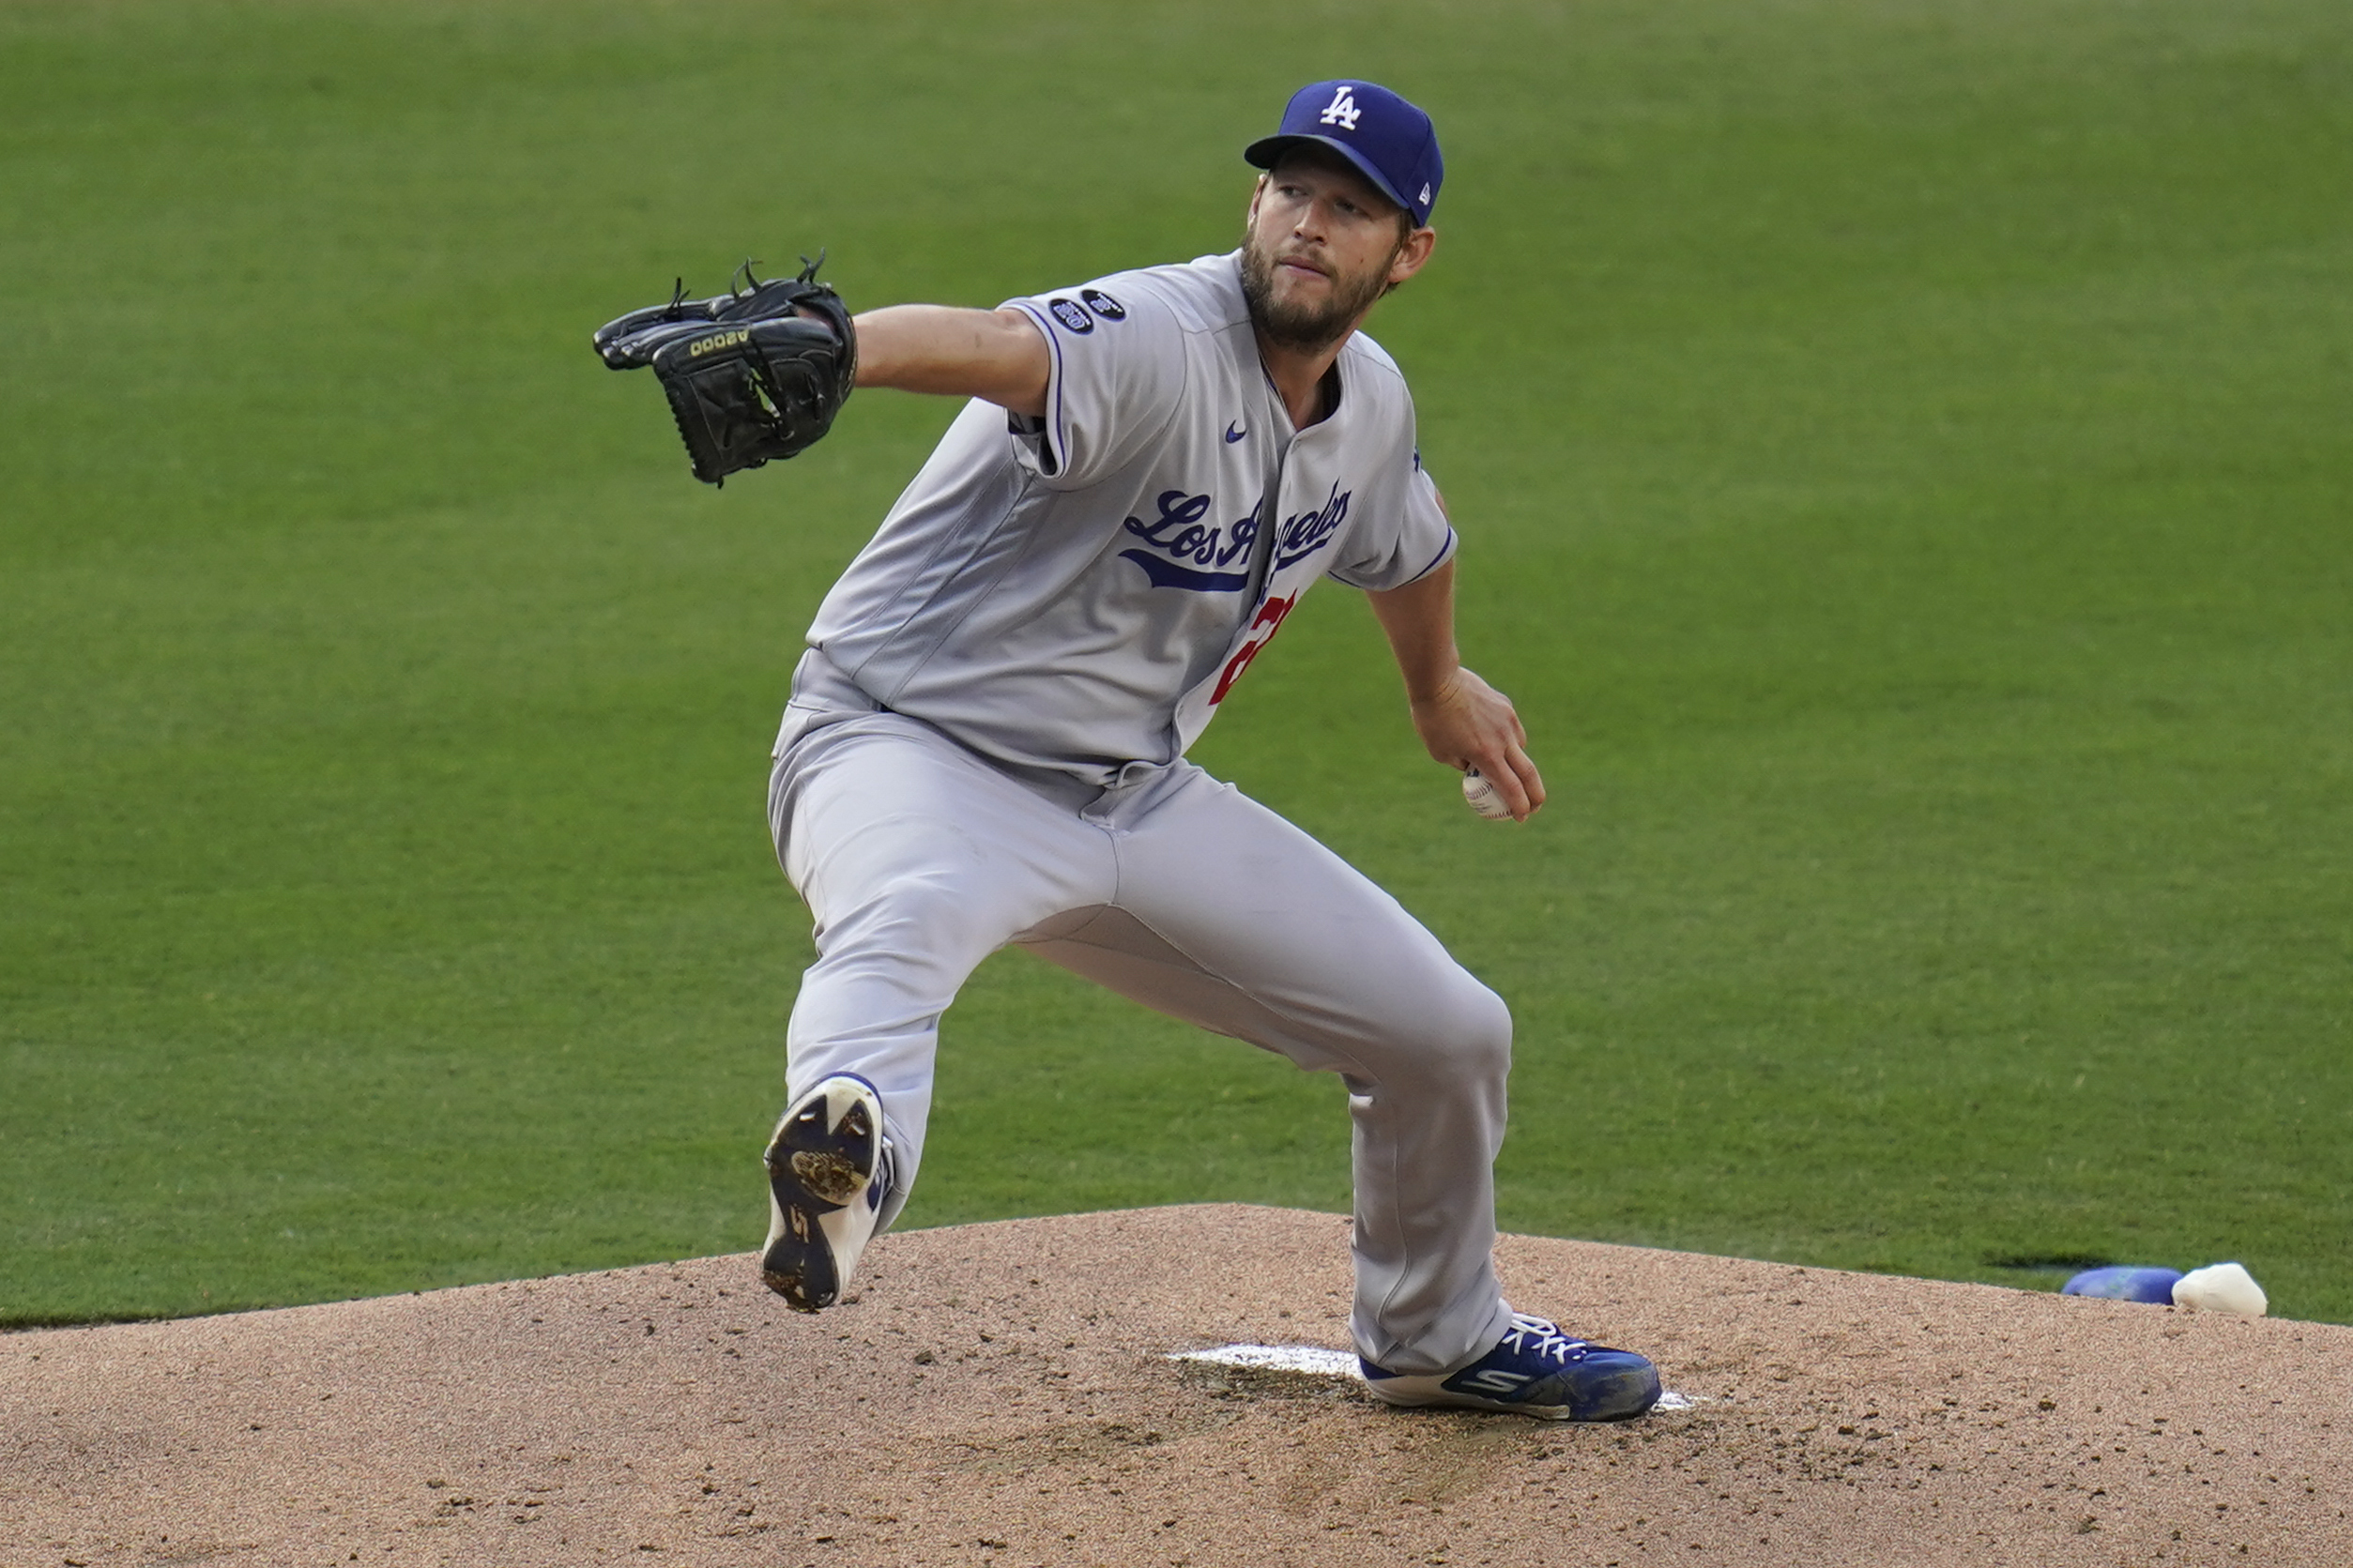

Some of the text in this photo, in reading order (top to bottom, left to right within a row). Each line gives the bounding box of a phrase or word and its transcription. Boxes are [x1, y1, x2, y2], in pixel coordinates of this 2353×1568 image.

[1320, 85, 1361, 130] LA
[690, 329, 750, 357] A2000
[1123, 490, 1221, 565] Los
